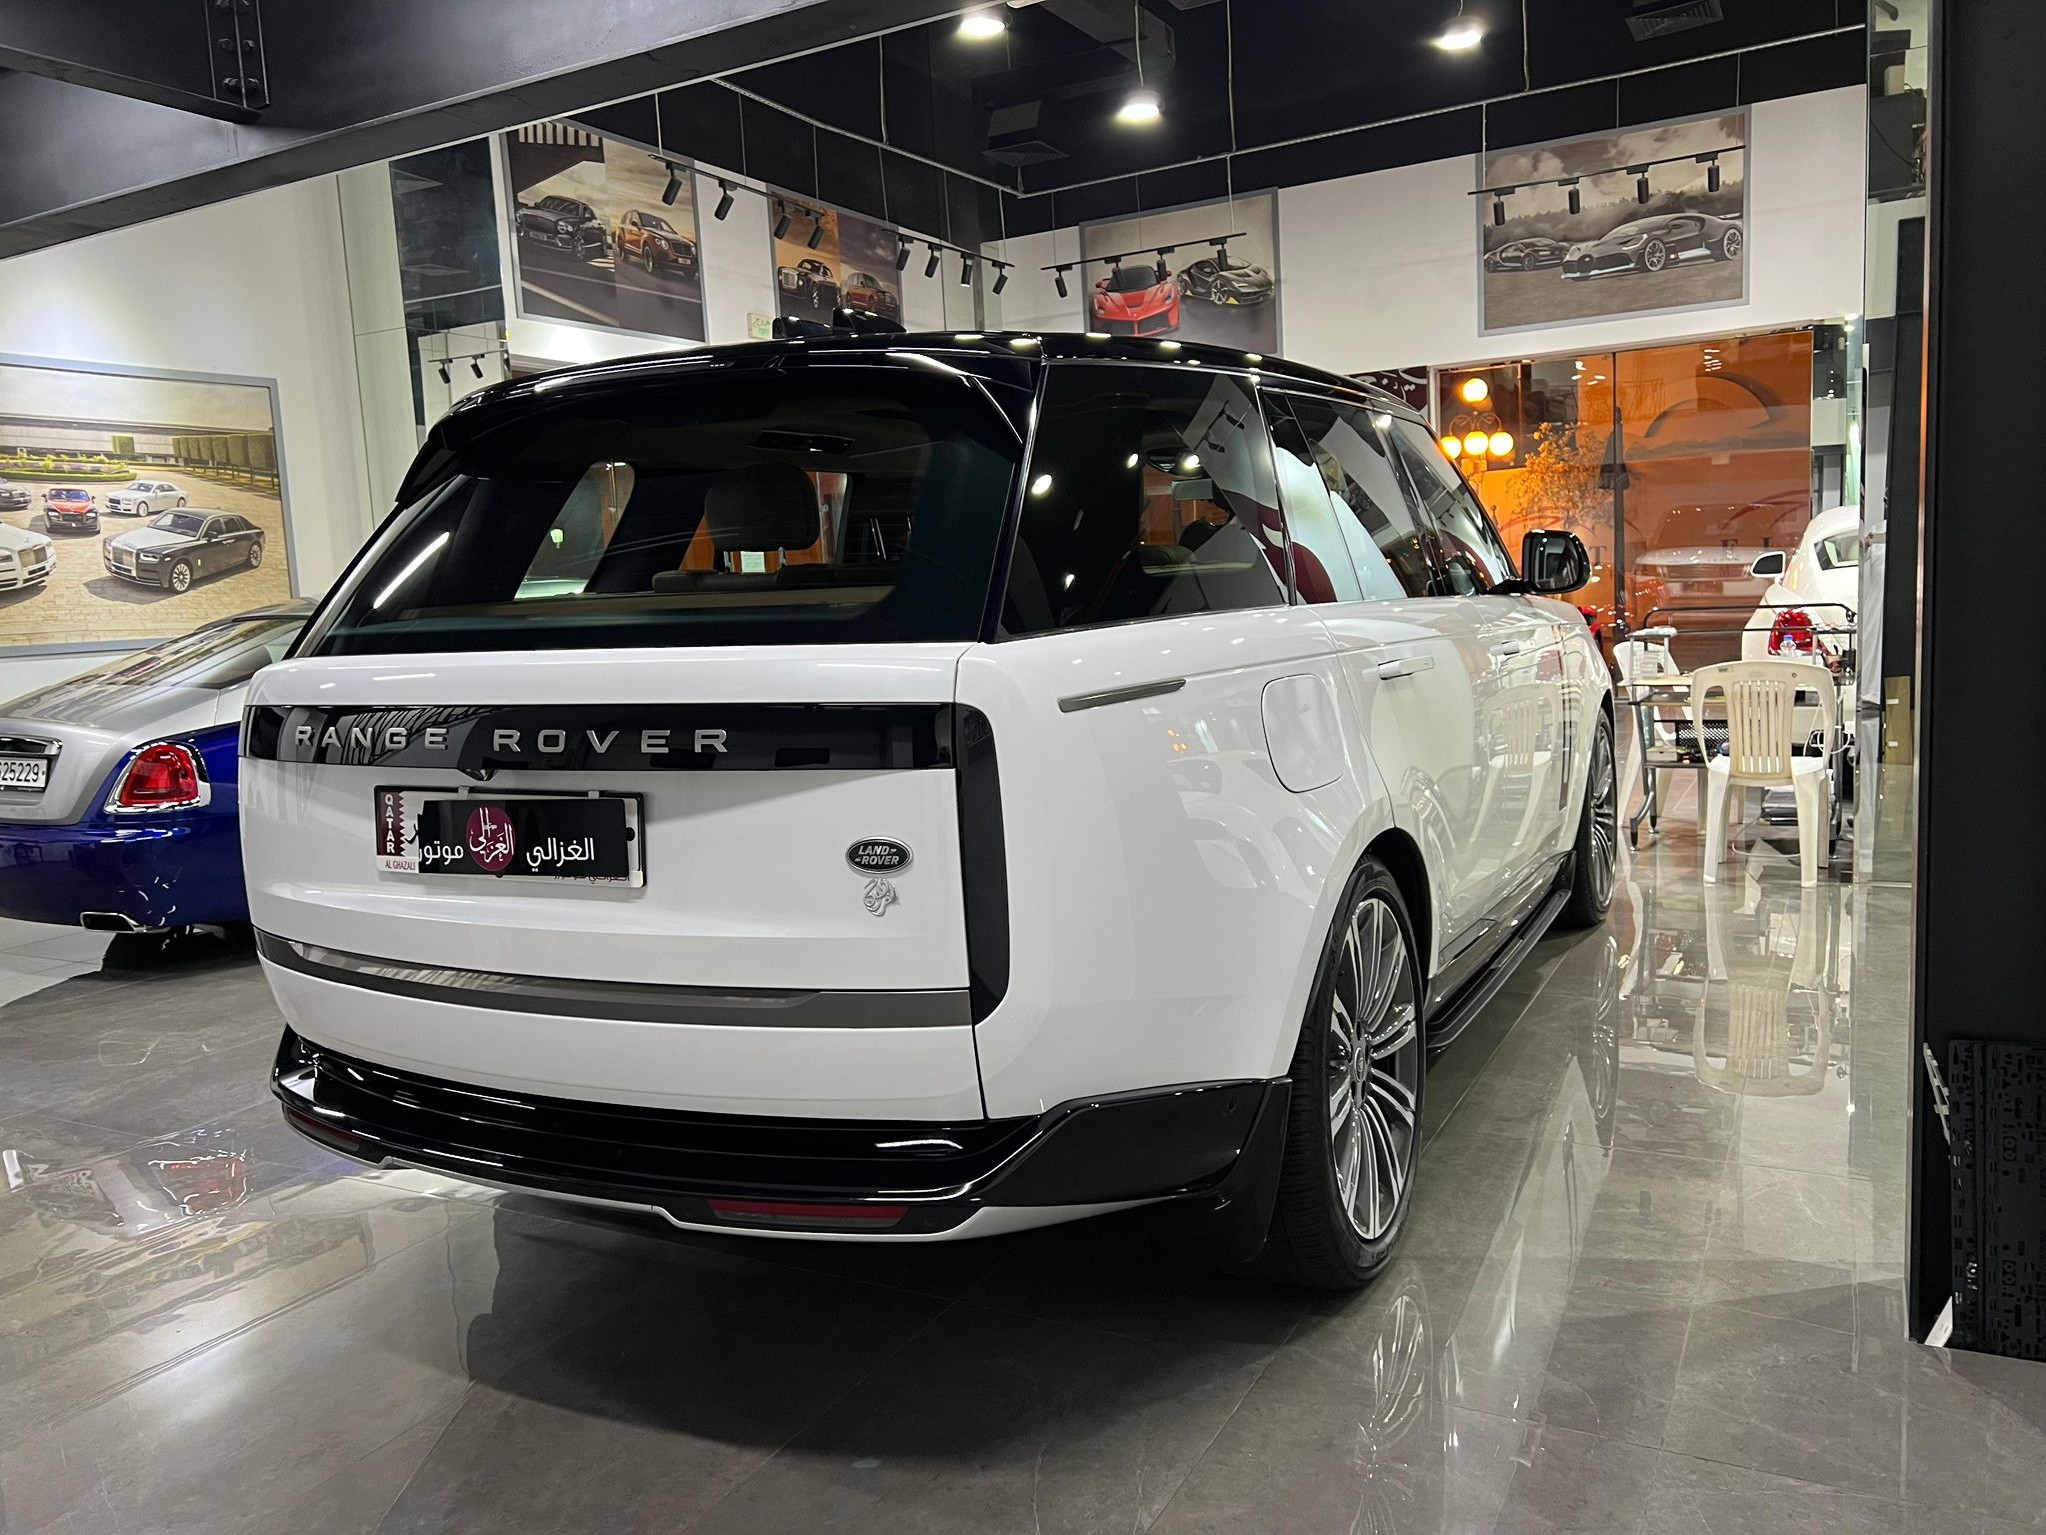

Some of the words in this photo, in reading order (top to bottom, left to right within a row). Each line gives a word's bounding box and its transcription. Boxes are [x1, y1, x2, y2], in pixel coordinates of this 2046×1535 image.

[294, 725, 448, 751] RANGE
[492, 728, 728, 754] ROVER
[0, 761, 40, 783] 25229
[385, 794, 395, 853] QATAR
[526, 837, 595, 872] الغزالي
[858, 845, 890, 855] LAND
[861, 855, 900, 865] ROVER
[385, 860, 391, 869] AL
[393, 860, 416, 871] GHAZALI
